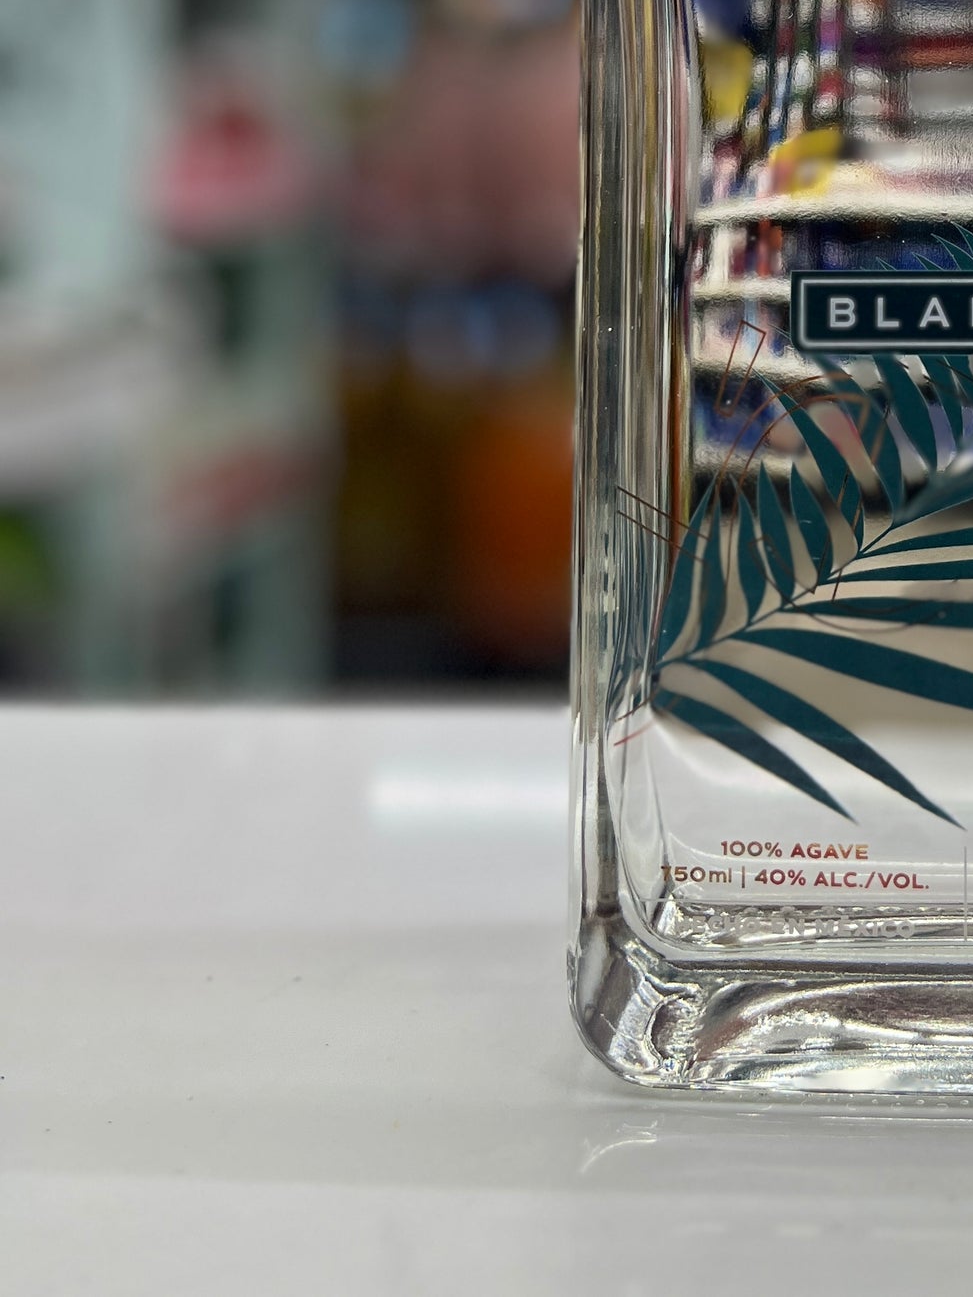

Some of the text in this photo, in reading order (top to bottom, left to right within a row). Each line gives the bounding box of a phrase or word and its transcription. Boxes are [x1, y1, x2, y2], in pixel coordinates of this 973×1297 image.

[720, 839, 869, 861] 100% AGAVE
[660, 865, 930, 890] 750ml 40% ALC./VOL.
